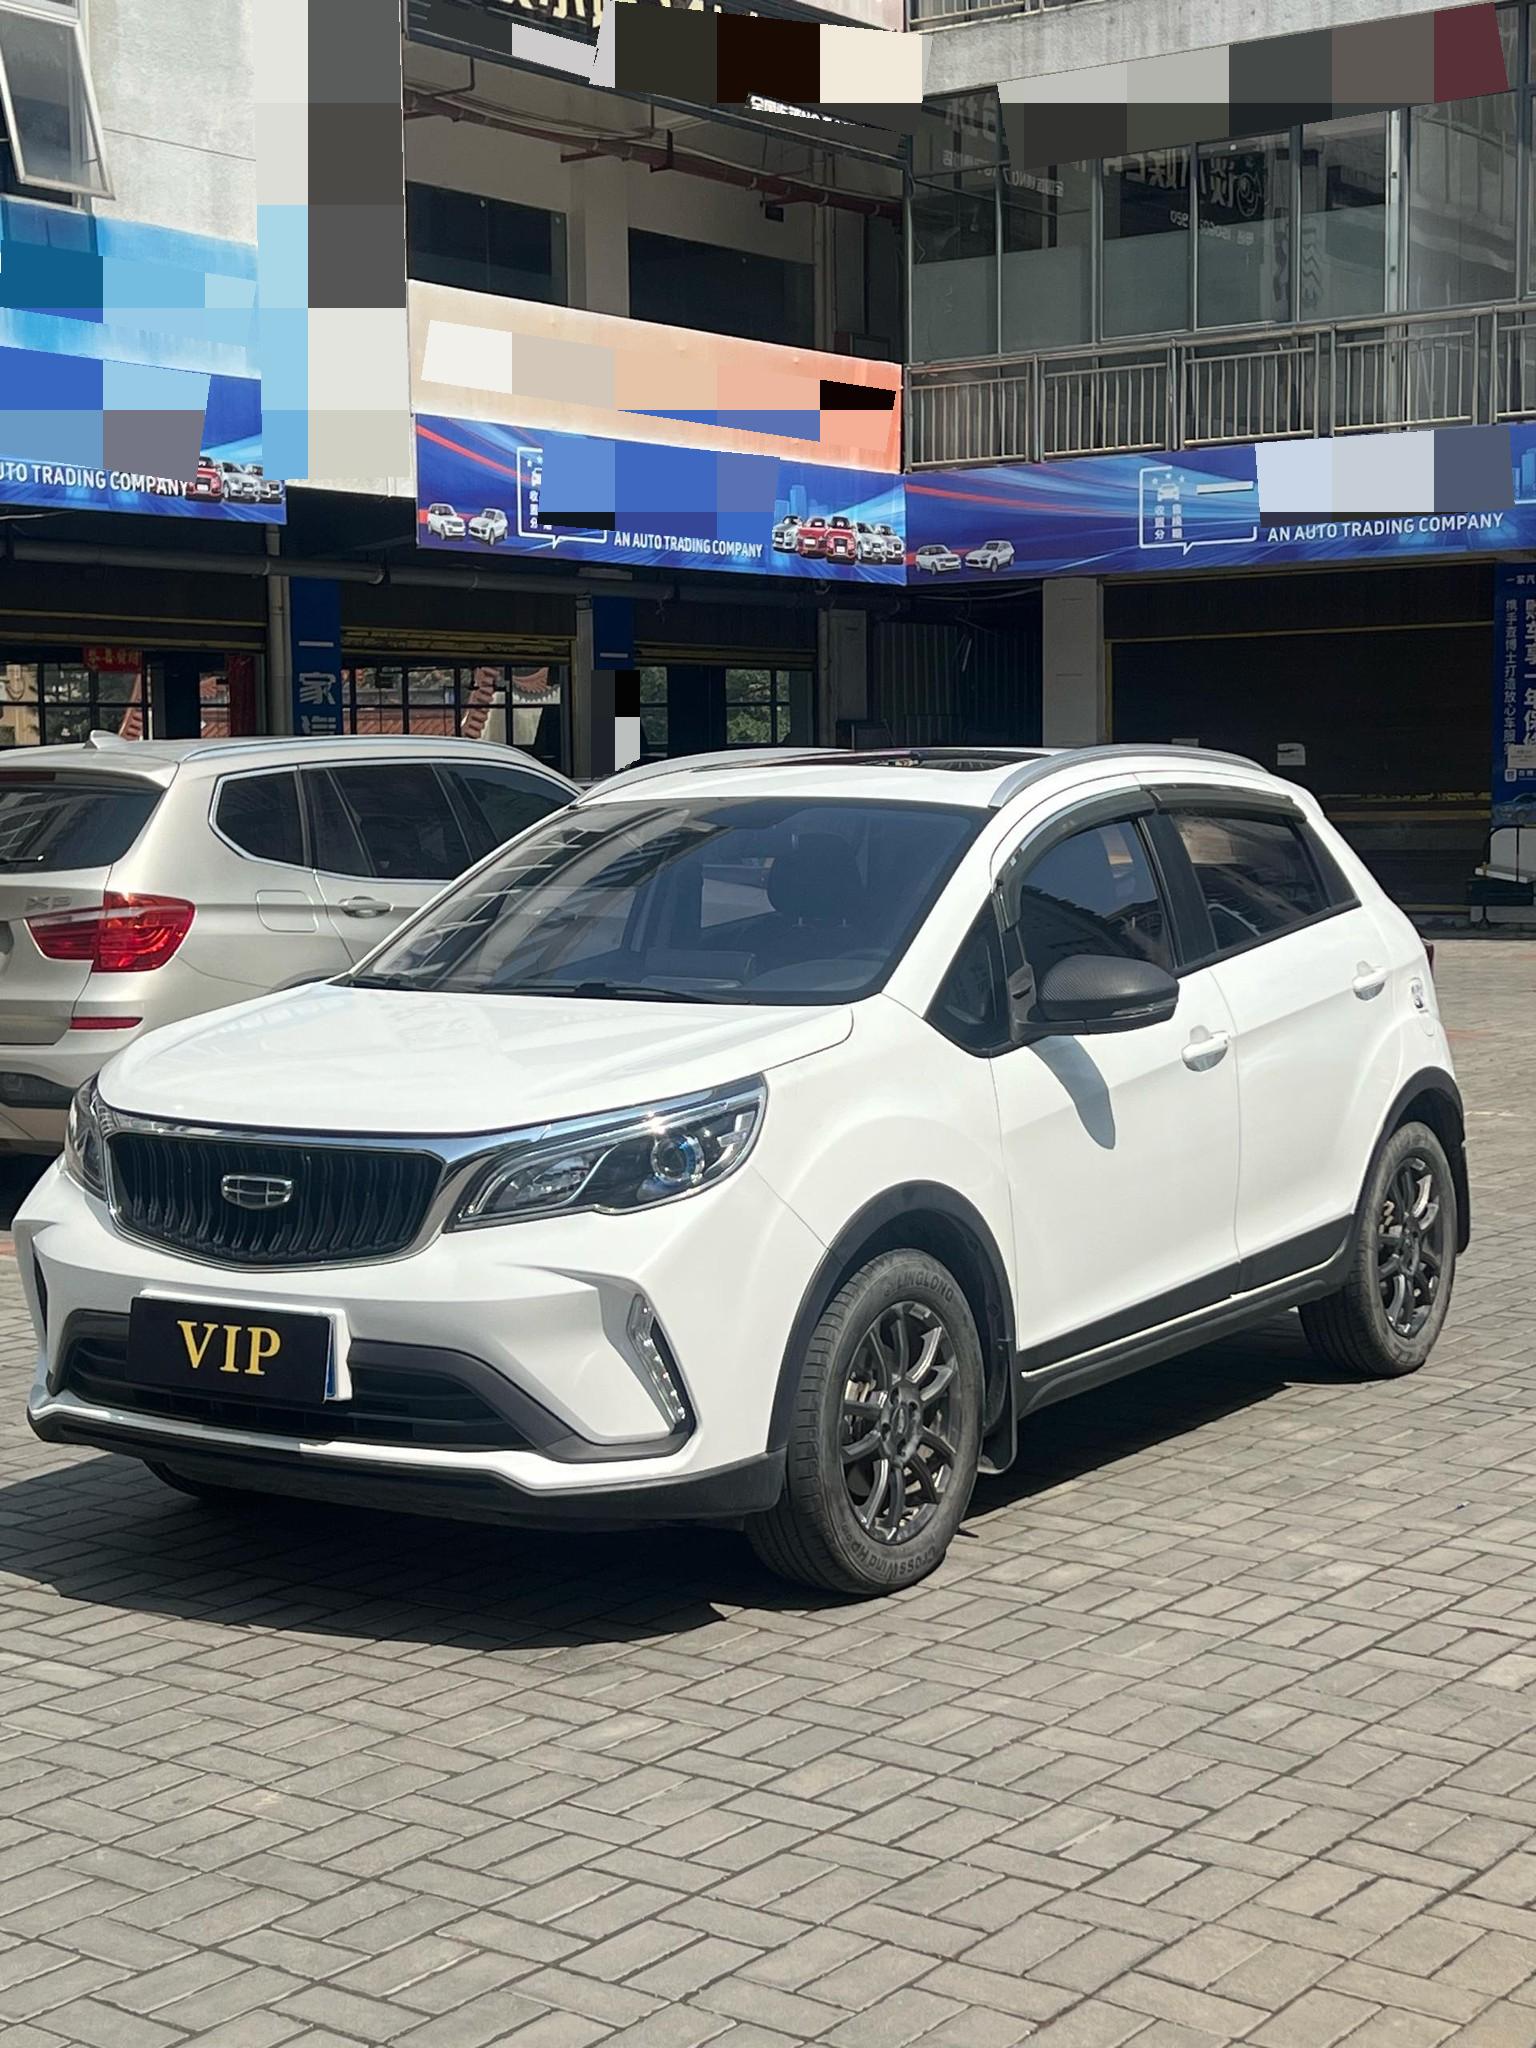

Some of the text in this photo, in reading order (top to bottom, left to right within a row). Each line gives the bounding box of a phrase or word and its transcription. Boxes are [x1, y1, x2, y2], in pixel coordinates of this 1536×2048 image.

[31, 464, 106, 490] TRADING
[110, 471, 188, 497] COMPANY
[1267, 513, 1504, 542] AN AUTO TRADING COMPANY
[614, 531, 763, 557] AN AUTO TRADING COMPANY
[177, 1320, 281, 1376] VIP
